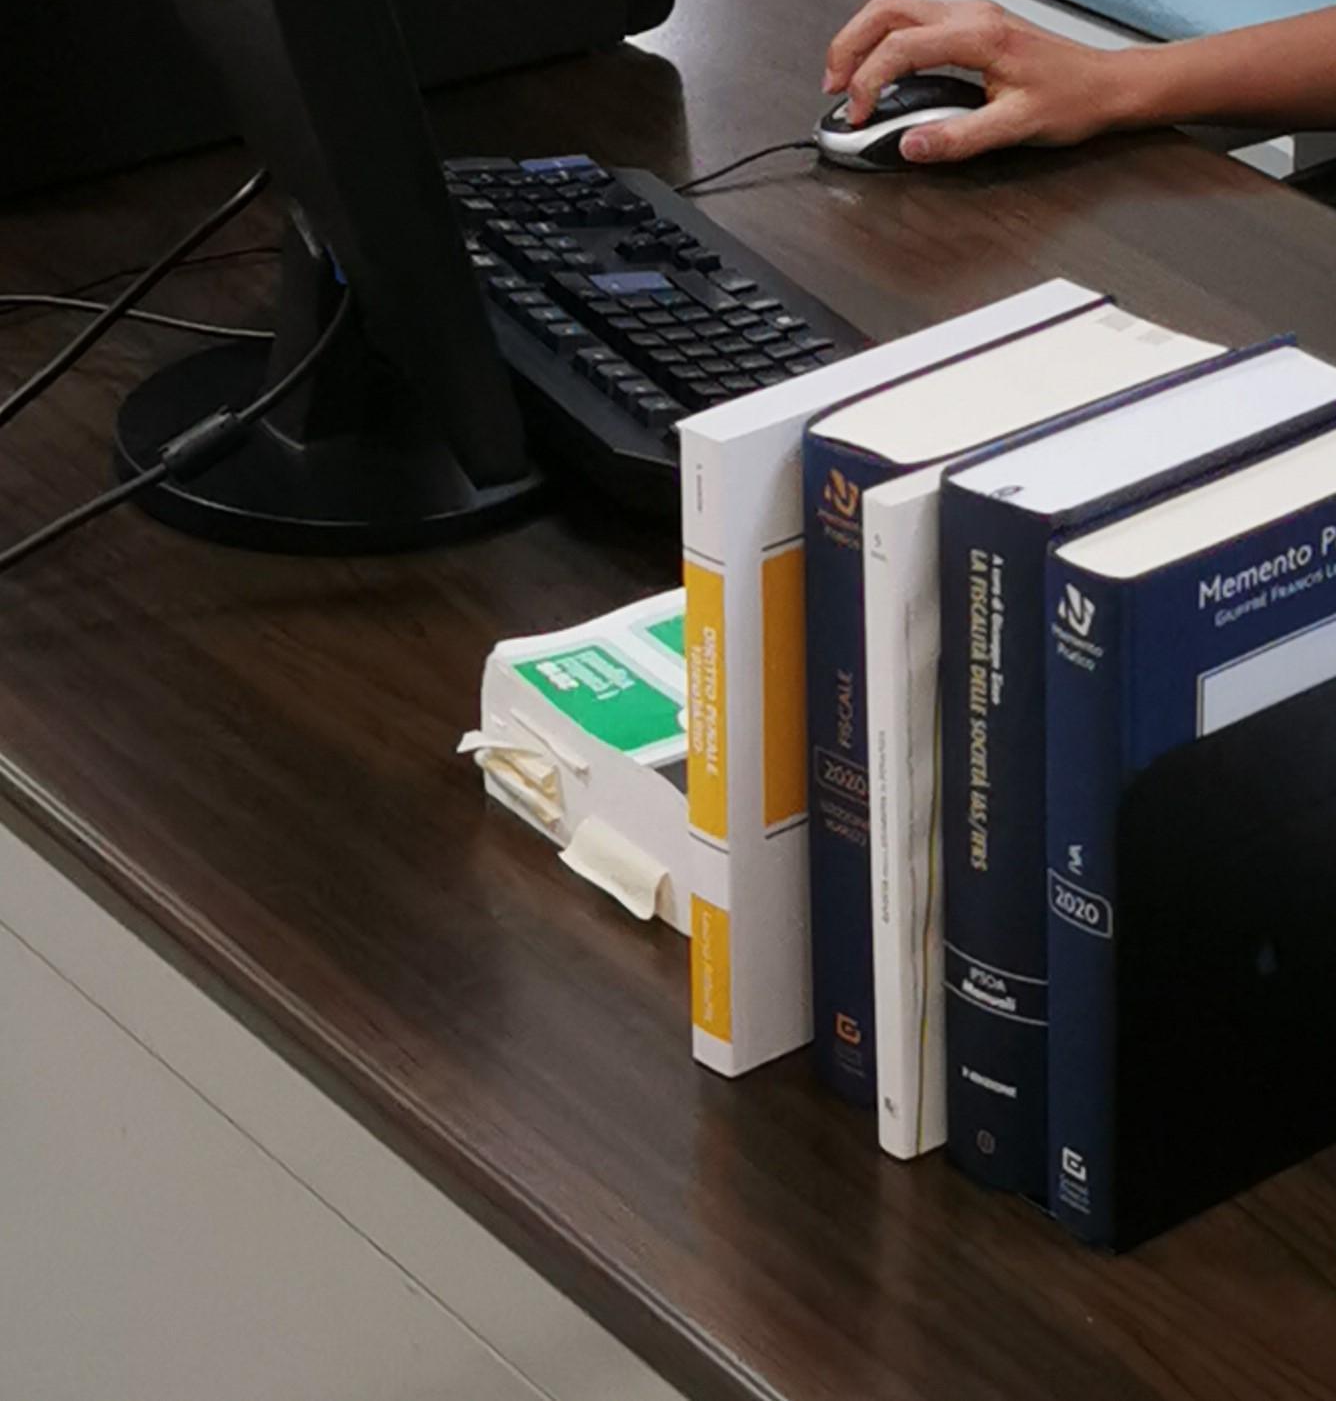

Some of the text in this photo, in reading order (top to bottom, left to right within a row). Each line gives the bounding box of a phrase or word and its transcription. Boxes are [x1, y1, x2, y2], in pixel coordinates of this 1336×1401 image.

[969, 548, 989, 573] LA
[1198, 544, 1313, 610] Memento
[836, 668, 855, 750] FISCALE
[969, 662, 989, 718] DELLE
[1055, 884, 1100, 925] 2020
